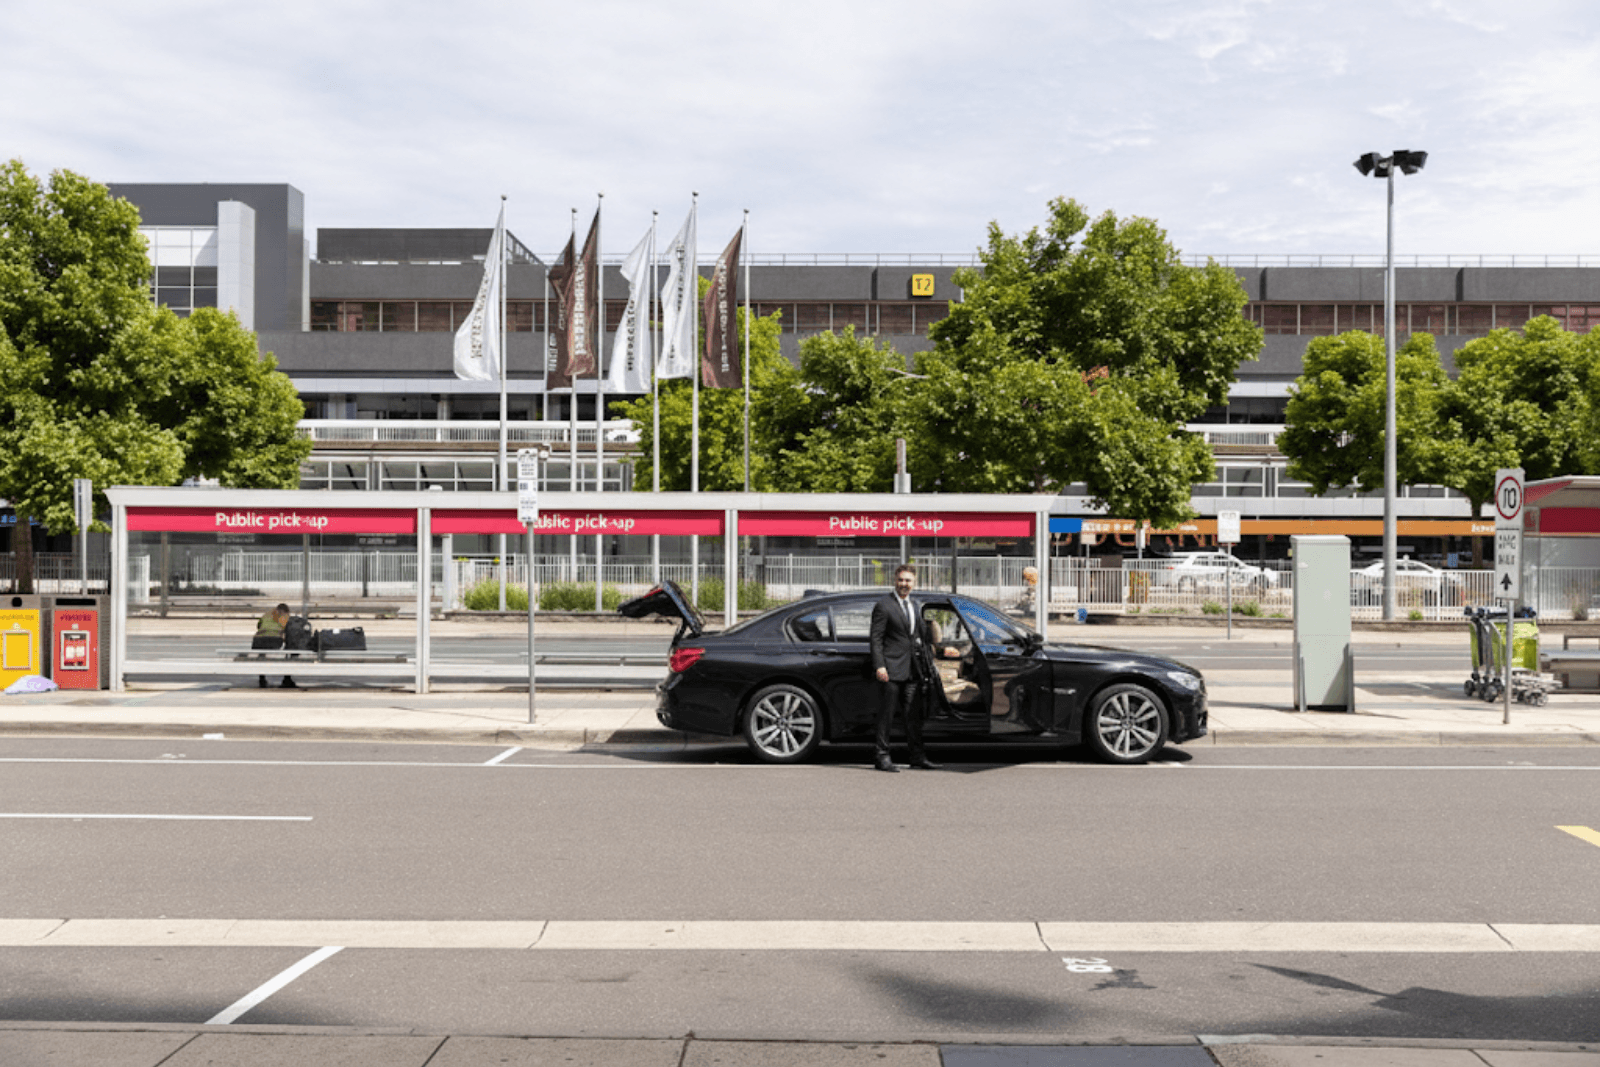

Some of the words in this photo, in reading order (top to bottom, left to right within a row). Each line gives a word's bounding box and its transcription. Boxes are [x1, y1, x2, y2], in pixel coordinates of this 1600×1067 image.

[1503, 488, 1517, 508] 10
[215, 511, 264, 527] Public
[268, 511, 328, 530] pick-up
[522, 513, 570, 529] ublic
[574, 513, 635, 533] pick-up
[829, 515, 879, 530] Public
[883, 515, 944, 534] pick-up
